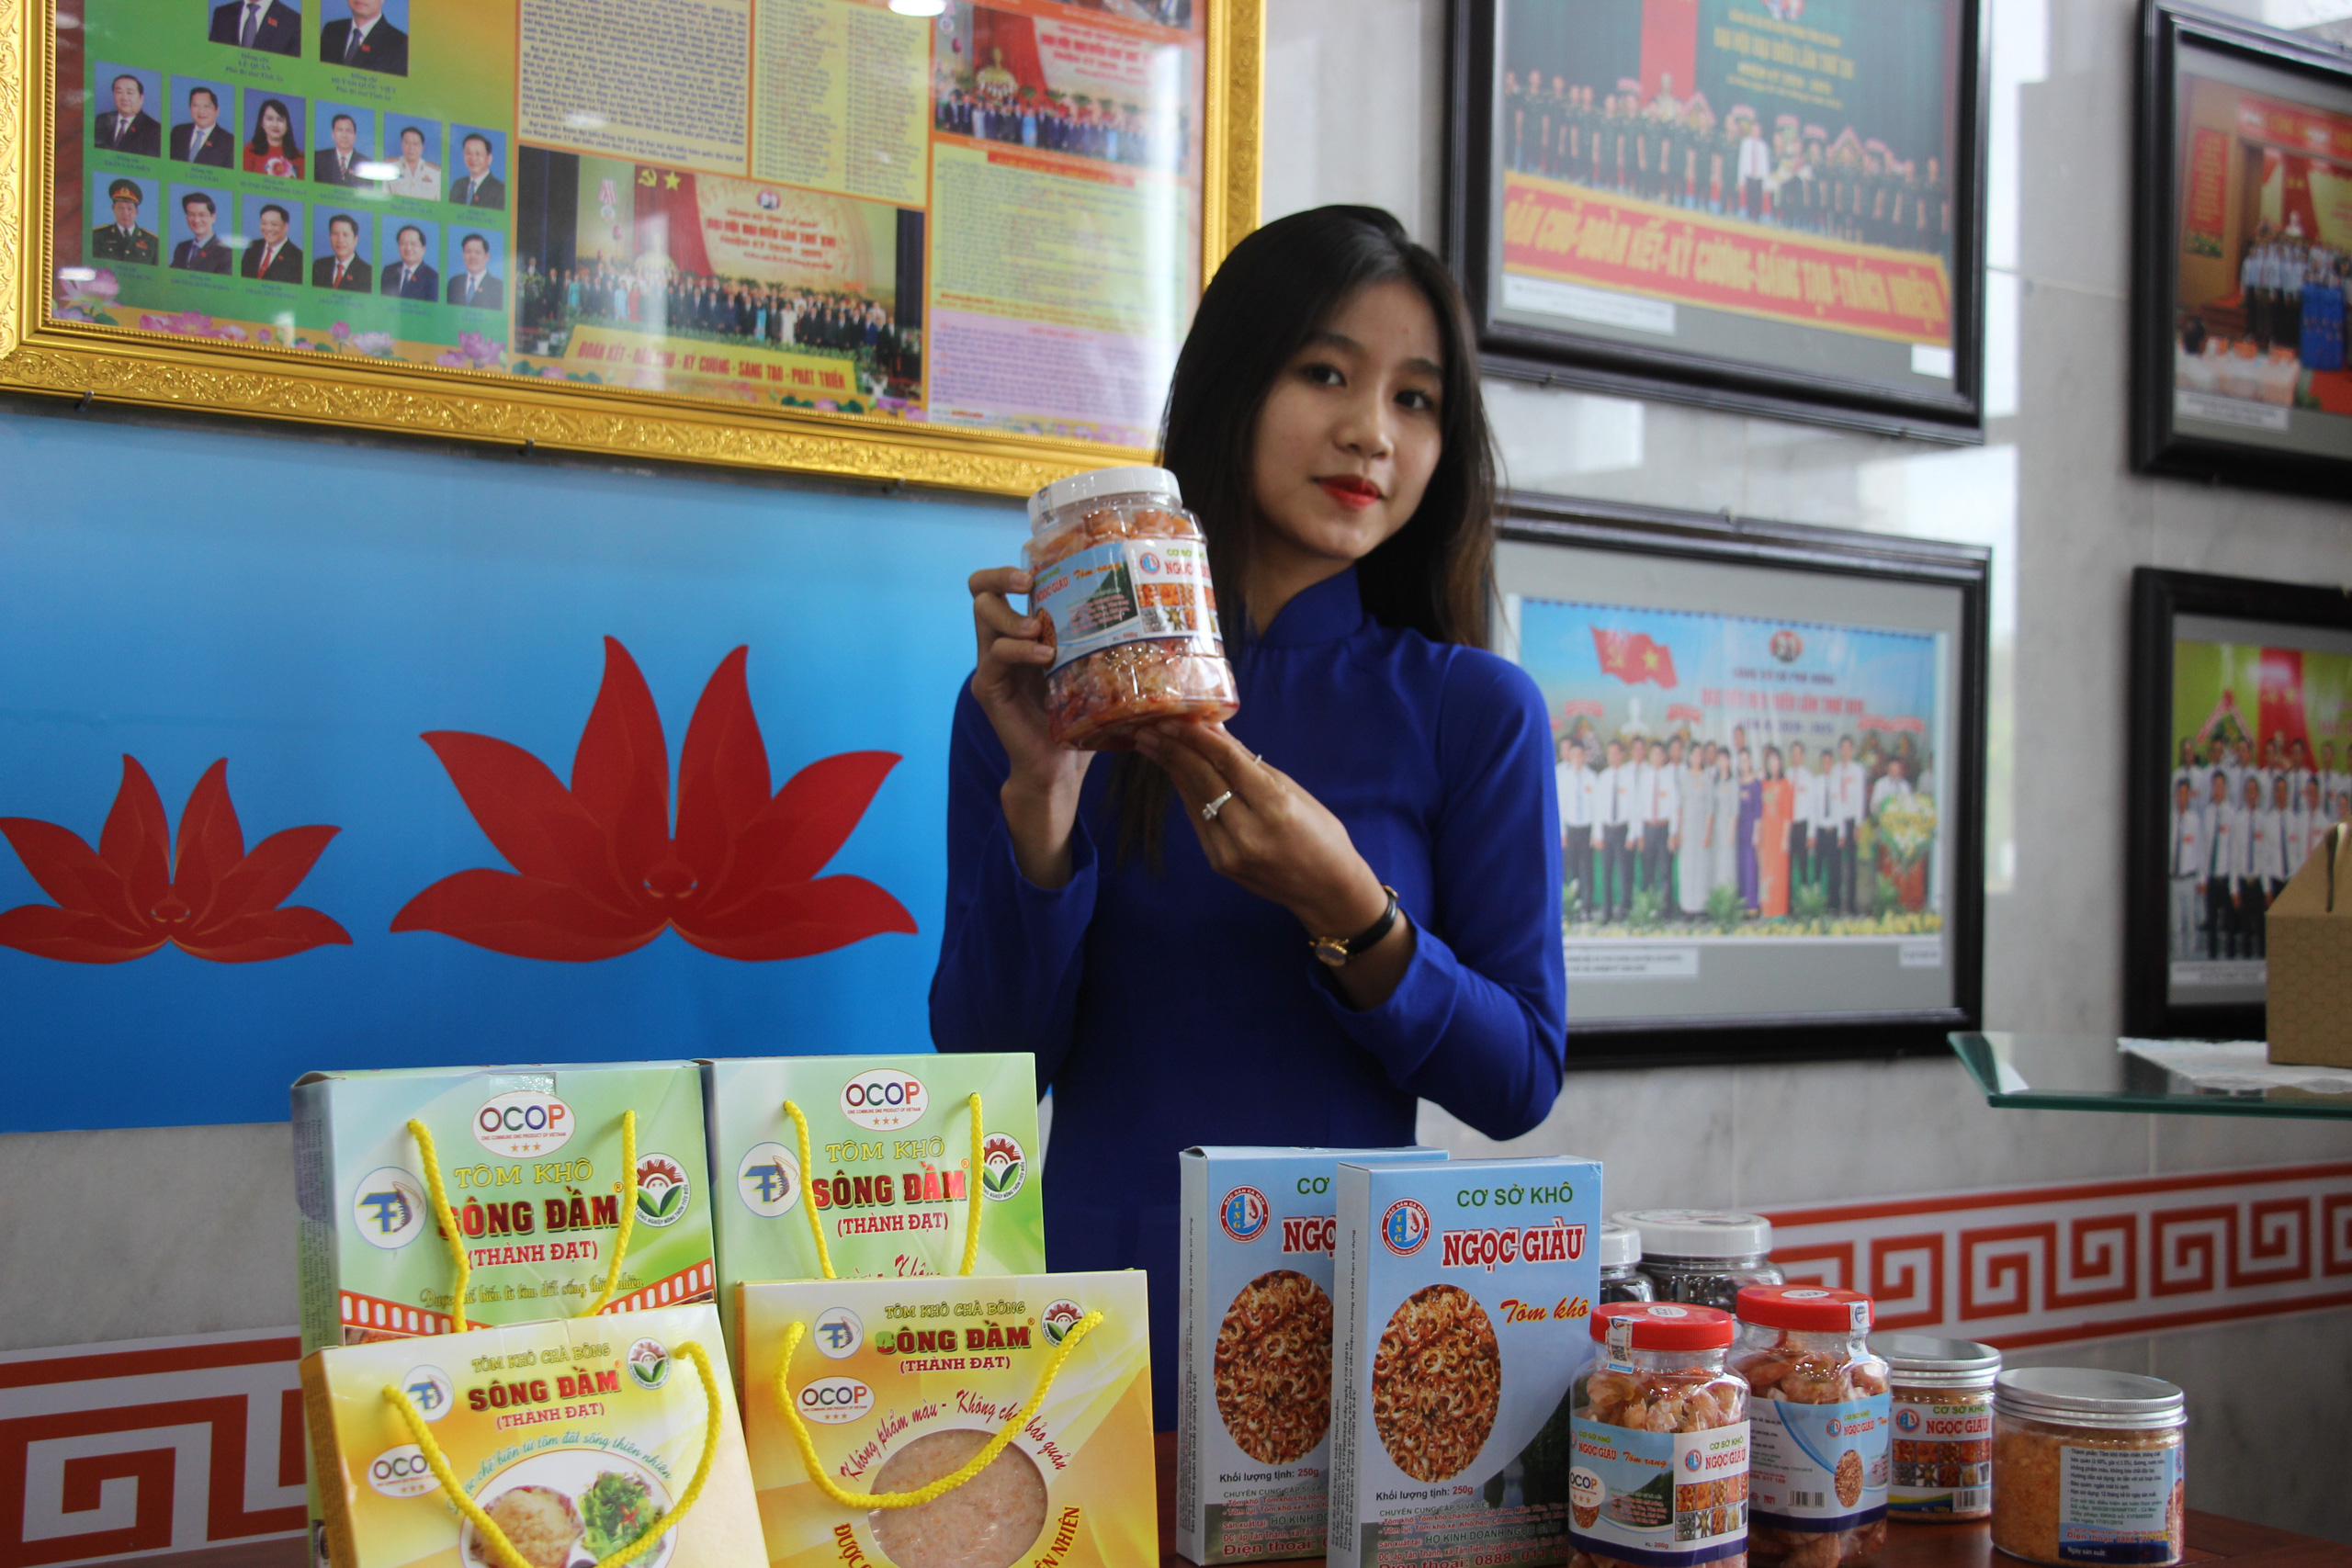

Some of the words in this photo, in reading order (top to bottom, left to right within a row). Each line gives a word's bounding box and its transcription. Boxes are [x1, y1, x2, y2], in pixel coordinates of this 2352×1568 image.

[577, 341, 605, 361] ĐOÀN
[792, 367, 815, 387] PHÁT
[846, 1081, 921, 1107] OCOP
[480, 1104, 566, 1133] OCOP
[826, 1140, 884, 1163] TÔM
[894, 1135, 944, 1159] KHÔ
[454, 1164, 522, 1189] TÔM
[534, 1157, 594, 1184] KHÔ
[1297, 1177, 1330, 1194] CƠ
[811, 1169, 895, 1211] SÔNG
[902, 1161, 967, 1204] ĐẦM
[1457, 1189, 1488, 1207] CƠ
[1494, 1183, 1524, 1206] SỞ
[1531, 1181, 1574, 1204] KHÔ
[545, 1185, 620, 1233] ĐẦM
[1255, 1193, 1265, 1205] MAU
[837, 1213, 904, 1237] (THÀNH
[908, 1212, 949, 1233] ĐẠT)
[1417, 1206, 1426, 1219] MAU
[1282, 1215, 1337, 1258] NGỌ
[1442, 1227, 1520, 1273] NGỌC
[1521, 1216, 1587, 1264] GIÀU
[469, 1242, 546, 1269] (THÀNH
[550, 1240, 599, 1264] ĐẠT)
[885, 1303, 916, 1319] TÔM
[921, 1302, 950, 1317] KHÔ
[954, 1299, 983, 1316] CHÀ
[987, 1301, 1025, 1315] BÔNG
[1499, 1299, 1547, 1324] Tôm
[1554, 1295, 1589, 1319] khô
[966, 1319, 1031, 1351] ĐẦM
[471, 1355, 504, 1372] TÔM
[508, 1349, 537, 1368] KHÔ
[540, 1345, 571, 1364] CHÀ
[573, 1342, 611, 1360] BÔNG
[899, 1356, 966, 1374] (THÀNH
[969, 1355, 1012, 1371] ĐẠT)
[468, 1380, 552, 1412] SÔNG
[557, 1366, 622, 1400] ĐẦM
[802, 1385, 867, 1405] OCOP
[496, 1408, 560, 1430] (THÀNH
[566, 1402, 605, 1419] ĐẠT)
[1933, 1405, 1950, 1415] CƠ
[1951, 1404, 1967, 1415] SỞ
[840, 1440, 879, 1482] Không
[876, 1409, 909, 1450] phẩm
[912, 1398, 938, 1423] màu
[956, 1389, 996, 1423] Không
[1024, 1415, 1047, 1441] bảo
[1037, 1440, 1071, 1470] quản
[1844, 1424, 1861, 1436] NGỌC
[1926, 1418, 1963, 1438] NGỌC
[1964, 1413, 1989, 1433] GIÀU
[537, 1435, 559, 1449] tôm
[562, 1429, 581, 1444] đất
[582, 1432, 610, 1450] sống
[612, 1437, 641, 1457] thiên
[642, 1449, 673, 1479] nhiên
[1578, 1441, 1598, 1458] NGỌC
[1599, 1444, 1618, 1461] GIÀU
[1709, 1441, 1720, 1451] CƠ
[1721, 1438, 1731, 1450] SỞ
[1732, 1436, 1744, 1447] KHÔ
[374, 1454, 427, 1480] OCO
[1623, 1450, 1642, 1465] Tôm
[1645, 1458, 1668, 1469] rang
[1705, 1451, 1729, 1470] NGỌC
[1729, 1445, 1747, 1464] GIÀU
[1219, 1472, 1241, 1483] Khối
[1244, 1472, 1272, 1482] lượng
[1274, 1470, 1295, 1480] tịnh:
[1297, 1467, 1319, 1478] 250g
[1570, 1472, 1598, 1490] OCOP
[1376, 1487, 1397, 1501] Khối
[1399, 1488, 1428, 1501] lượng
[1430, 1487, 1450, 1499] tịnh:
[1453, 1485, 1474, 1495] 250g
[1289, 1514, 1314, 1524] KINH
[833, 1522, 865, 1568] ĐƯỢC
[1050, 1506, 1080, 1559] NHIÊN
[1443, 1532, 1466, 1542] KINH
[1470, 1529, 1504, 1540] DOANH
[1223, 1543, 1262, 1557] Điện
[1268, 1540, 1316, 1552] thoại:
[1475, 1551, 1516, 1566] 0888.
[1521, 1549, 1545, 1561] 011
[1553, 1545, 1569, 1558] 18
